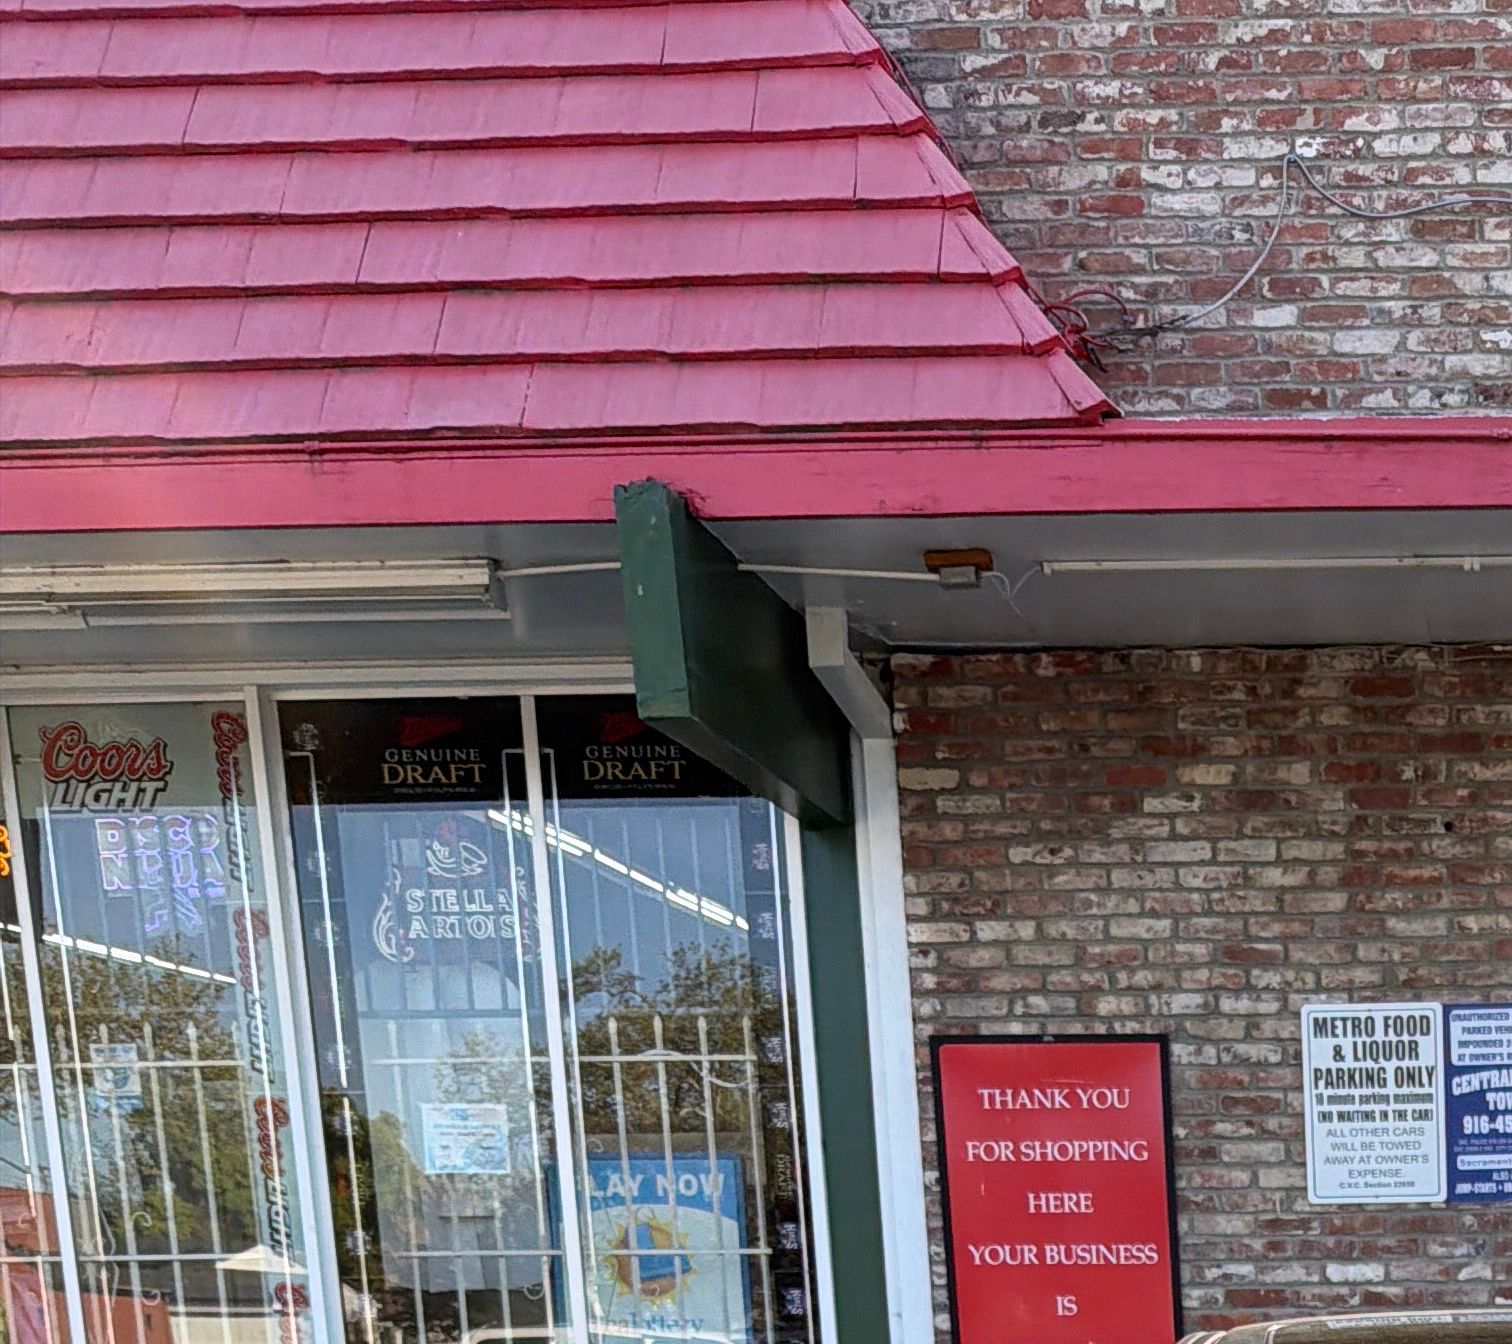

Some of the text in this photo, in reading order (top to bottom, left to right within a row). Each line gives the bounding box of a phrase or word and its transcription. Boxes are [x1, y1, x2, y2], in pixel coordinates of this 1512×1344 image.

[40, 721, 173, 781] Coors
[385, 748, 481, 763] GENUINE
[586, 745, 682, 759] GENUINE
[381, 763, 486, 785] DRAFT
[583, 759, 687, 782] DRAFT
[48, 779, 168, 813] LIGHT
[406, 888, 514, 913] STELLA
[408, 915, 516, 940] ARTOIS
[1312, 1014, 1431, 1039] METRO FOOD
[1461, 1026, 1492, 1036] PARKED
[1332, 1039, 1420, 1064] & LIQUOR
[1457, 1039, 1504, 1050] IMPOUNDED
[1457, 1053, 1468, 1063] AT
[1313, 1065, 1436, 1091] PARKING ONLY
[978, 1088, 1130, 1110] THANK YOU
[1336, 1109, 1377, 1124] WAITING
[1379, 1110, 1389, 1123] IN
[1392, 1109, 1409, 1122] THE
[1325, 1127, 1425, 1138] ALL OTHER CARS
[966, 1140, 1150, 1162] FOR SHOPPING
[1330, 1140, 1422, 1152] WILL BE TOWED
[1323, 1154, 1430, 1166] AWAY AT OWNER'S
[577, 1173, 725, 1199] LAY NOW
[1027, 1193, 1095, 1214] HERE
[968, 1244, 1159, 1266] YOUR BUSINESS
[1056, 1295, 1078, 1316] IS
